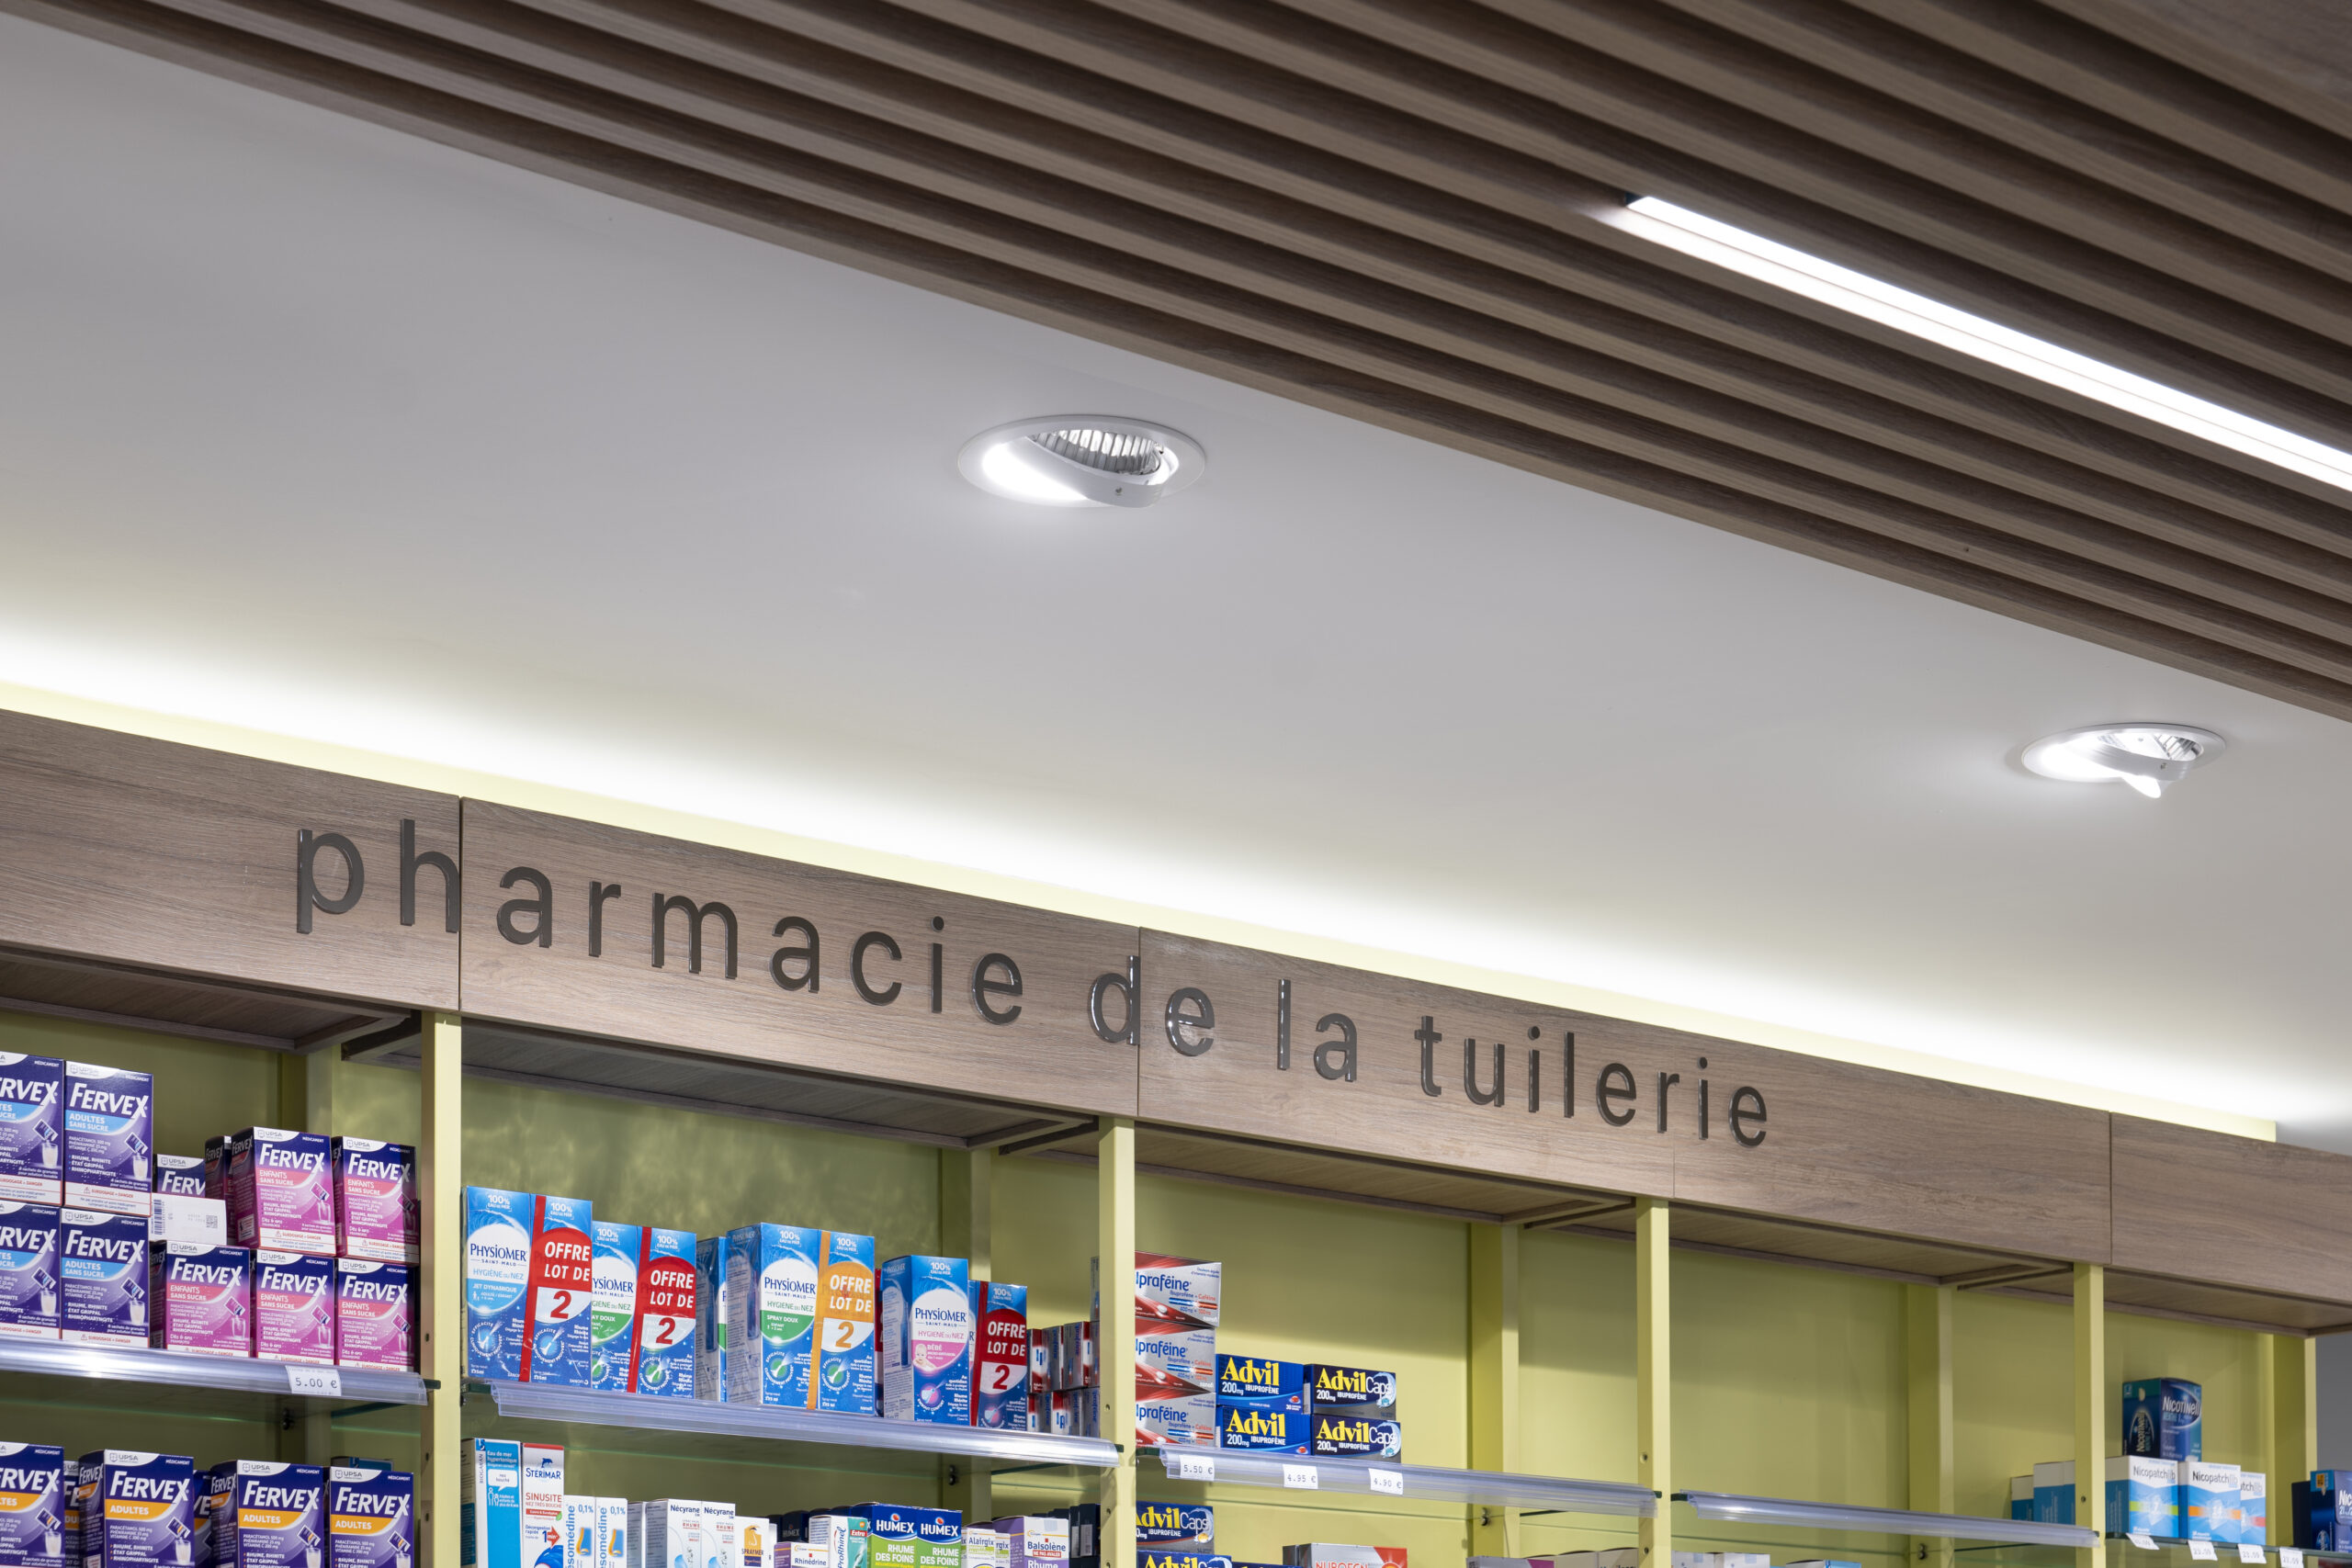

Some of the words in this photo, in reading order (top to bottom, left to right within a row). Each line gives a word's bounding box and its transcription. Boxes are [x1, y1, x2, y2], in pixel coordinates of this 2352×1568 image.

[297, 818, 1023, 1025] pharmacie
[1087, 954, 1216, 1058] de
[1276, 977, 1358, 1083] la
[1414, 1014, 1768, 1147] tuilerie
[0, 1077, 60, 1107] RVEX
[69, 1082, 149, 1119] FERVEX
[69, 1113, 106, 1124] ADULTES
[69, 1121, 87, 1129] SANS
[88, 1123, 109, 1132] SUCRE
[258, 1143, 325, 1174] FERVEX
[259, 1169, 287, 1179] ENFANTS
[347, 1153, 412, 1183] FERVEX
[161, 1170, 206, 1196] FERV
[347, 1179, 375, 1189] ENFANTS
[488, 1194, 511, 1205] 100%
[550, 1201, 573, 1214] 100%
[597, 1228, 619, 1238] 100%
[779, 1230, 801, 1241] 100%
[0, 1226, 57, 1255] RVEX
[657, 1235, 678, 1245] 100%
[836, 1236, 857, 1248] 100%
[64, 1229, 145, 1265] FERVEX
[544, 1241, 591, 1262] OFFRE
[64, 1259, 101, 1270] ADULTES
[930, 1261, 951, 1271] 100%
[64, 1268, 83, 1276] SANS
[84, 1269, 105, 1278] SUCRE
[170, 1257, 243, 1288] FERVEX
[544, 1263, 569, 1280] LOT
[572, 1266, 591, 1282] DE
[260, 1266, 328, 1297] FERVEX
[592, 1276, 634, 1293] YSiOMER
[650, 1269, 695, 1290] OFFRE
[830, 1274, 872, 1294] OFFRE
[170, 1284, 200, 1294] ENFANTS
[342, 1274, 408, 1305] FERVEX
[483, 1284, 517, 1293] DYNAMIQUE
[992, 1287, 1012, 1297] 100%
[260, 1293, 288, 1303] ENFANTS
[650, 1291, 673, 1306] LOT
[676, 1293, 695, 1309] DE
[1197, 1292, 1216, 1302] Caféine
[342, 1302, 369, 1311] ENFANTS
[549, 1290, 572, 1320] 2
[618, 1303, 632, 1311] NEZ
[830, 1295, 853, 1310] LOT
[854, 1298, 872, 1314] DE
[655, 1316, 676, 1346] 2
[834, 1321, 854, 1348] 2
[987, 1320, 1026, 1339] OFFRE
[927, 1343, 943, 1351] BÉBÉ
[987, 1341, 1008, 1355] LOT
[1011, 1343, 1026, 1357] DE
[1194, 1359, 1212, 1367] Caféine
[992, 1364, 1011, 1391] 2
[1220, 1356, 1280, 1387] Advil
[295, 1377, 323, 1388] 5.00
[330, 1380, 338, 1389] €
[1221, 1381, 1244, 1395] 200mg
[1245, 1383, 1280, 1395] IBUPROFÈNE
[1316, 1389, 1336, 1402] 200mg
[1337, 1391, 1367, 1401] IBUPROFÈNE
[1194, 1423, 1213, 1431] Caféine
[1225, 1408, 1286, 1438] Advil
[1227, 1433, 1250, 1448] 200mg
[1250, 1435, 1286, 1446] IBUPROFÈNE
[1317, 1440, 1338, 1452] 200mg
[1338, 1441, 1371, 1450] IBUPROFÈNE
[79, 1462, 104, 1485] FERVEX
[1183, 1464, 1204, 1474] 5.50
[1207, 1466, 1214, 1475] €
[2132, 1465, 2177, 1481] Nicopatchlib
[0, 1467, 61, 1495] RVEX
[210, 1472, 237, 1495] FERVEX
[1310, 1475, 1317, 1483] €
[2192, 1471, 2238, 1485] Nicopatchlib
[109, 1470, 190, 1504] FERVEX
[243, 1480, 321, 1513] FERVEX
[334, 1486, 411, 1518] FERVEX
[526, 1492, 562, 1503] SINUSITE
[109, 1505, 150, 1516] ADULTES
[578, 1504, 594, 1515] 0,1%
[610, 1506, 626, 1517] 0,1%
[670, 1504, 700, 1515] Nécyrane
[704, 1506, 734, 1517] Nécyrane
[243, 1514, 281, 1524] ADULTES
[334, 1520, 372, 1529] ADULTES
[876, 1519, 914, 1534] HUMEX
[920, 1523, 959, 1537] HUMEX
[542, 1529, 548, 1543] 1
[1148, 1529, 1182, 1537] IBUPROFÈNE
[888, 1543, 915, 1554] RHUME
[968, 1537, 994, 1548] Alairgix
[1027, 1540, 1067, 1551] Balsolène
[875, 1552, 891, 1562] DES
[891, 1554, 915, 1564] FOINS
[932, 1547, 959, 1557] RHUME
[794, 1557, 827, 1566] Rhinédrine
[920, 1555, 936, 1564] DES
[936, 1557, 959, 1566] FOINS
